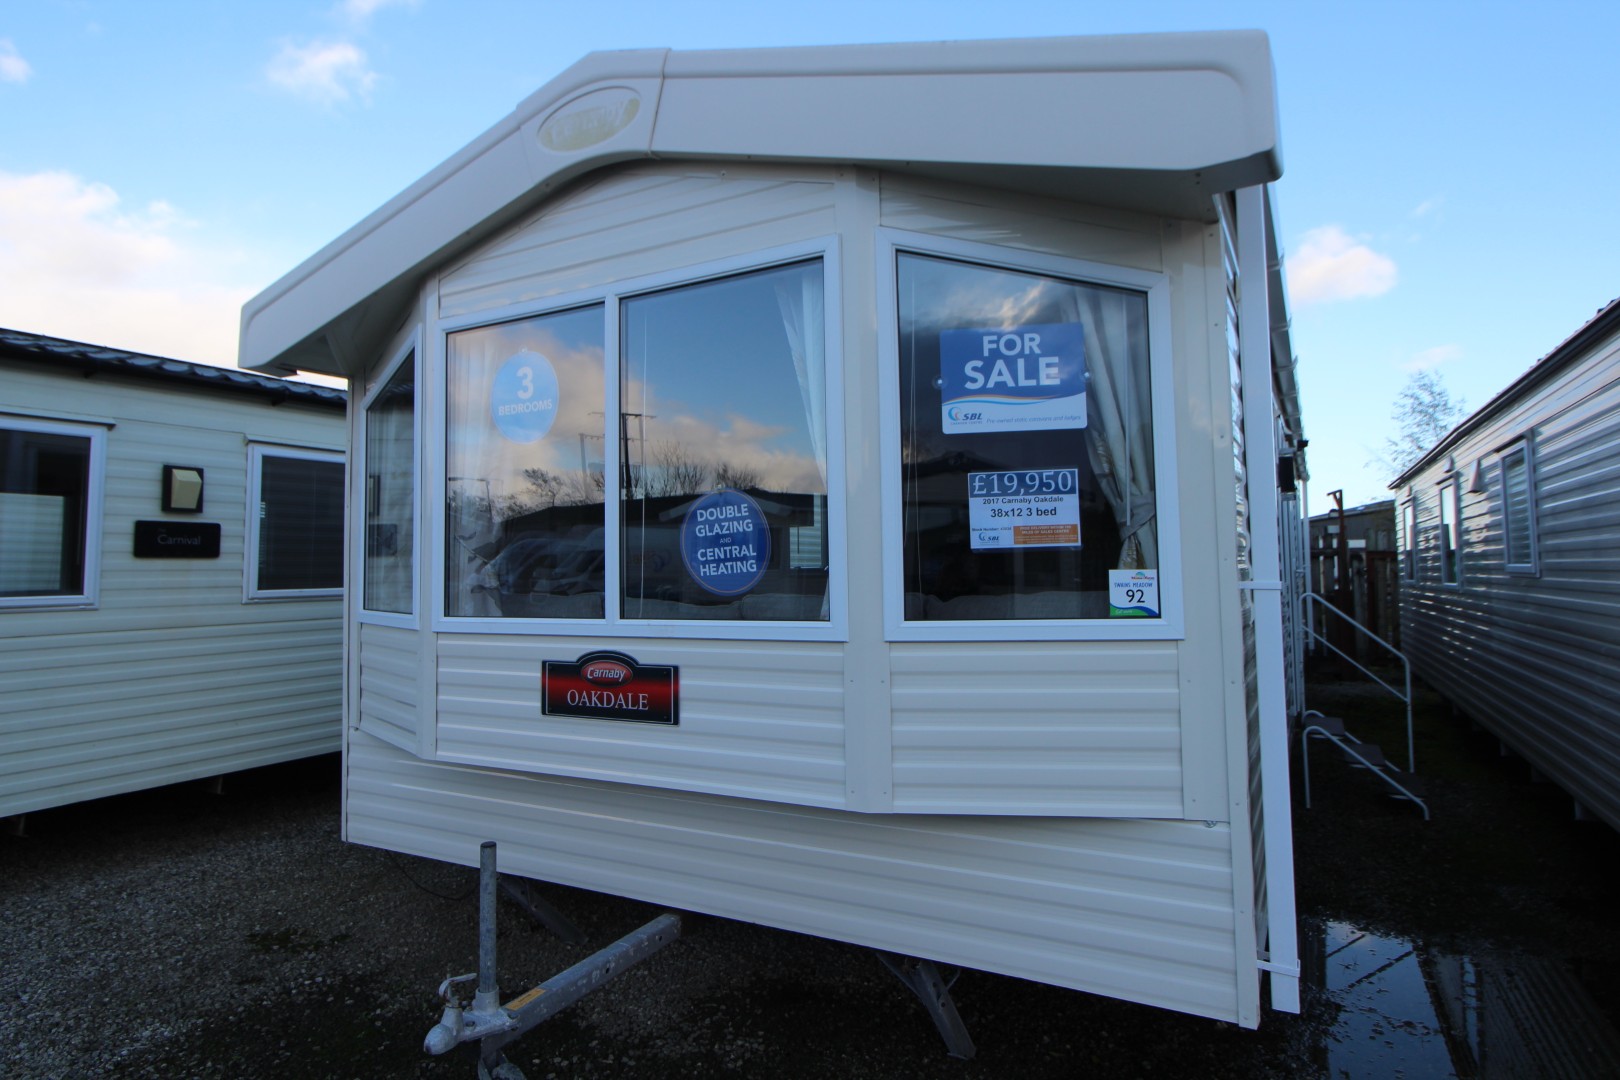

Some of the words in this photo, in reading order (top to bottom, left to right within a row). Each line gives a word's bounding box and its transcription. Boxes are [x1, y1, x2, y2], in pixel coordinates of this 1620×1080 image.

[983, 333, 1042, 357] FOR
[964, 356, 1061, 390] SALE
[516, 366, 534, 400] 3
[498, 399, 552, 416] BEDROOMS
[962, 413, 983, 421] SBL
[972, 471, 1072, 496] £19,950
[1001, 496, 1032, 505] Carnaby
[1034, 495, 1064, 503] Oakdale
[696, 504, 749, 522] DOUBLE
[990, 507, 1023, 518] 38x12
[1026, 507, 1033, 517] 3
[1036, 506, 1057, 517] bed
[695, 519, 753, 537] GLAZING
[157, 534, 202, 545] Carnival
[697, 544, 757, 561] CENTRAL
[700, 560, 757, 577] HEATING
[1126, 589, 1145, 603] 92
[587, 667, 626, 682] Carnaby
[567, 689, 649, 711] OAKDALE
